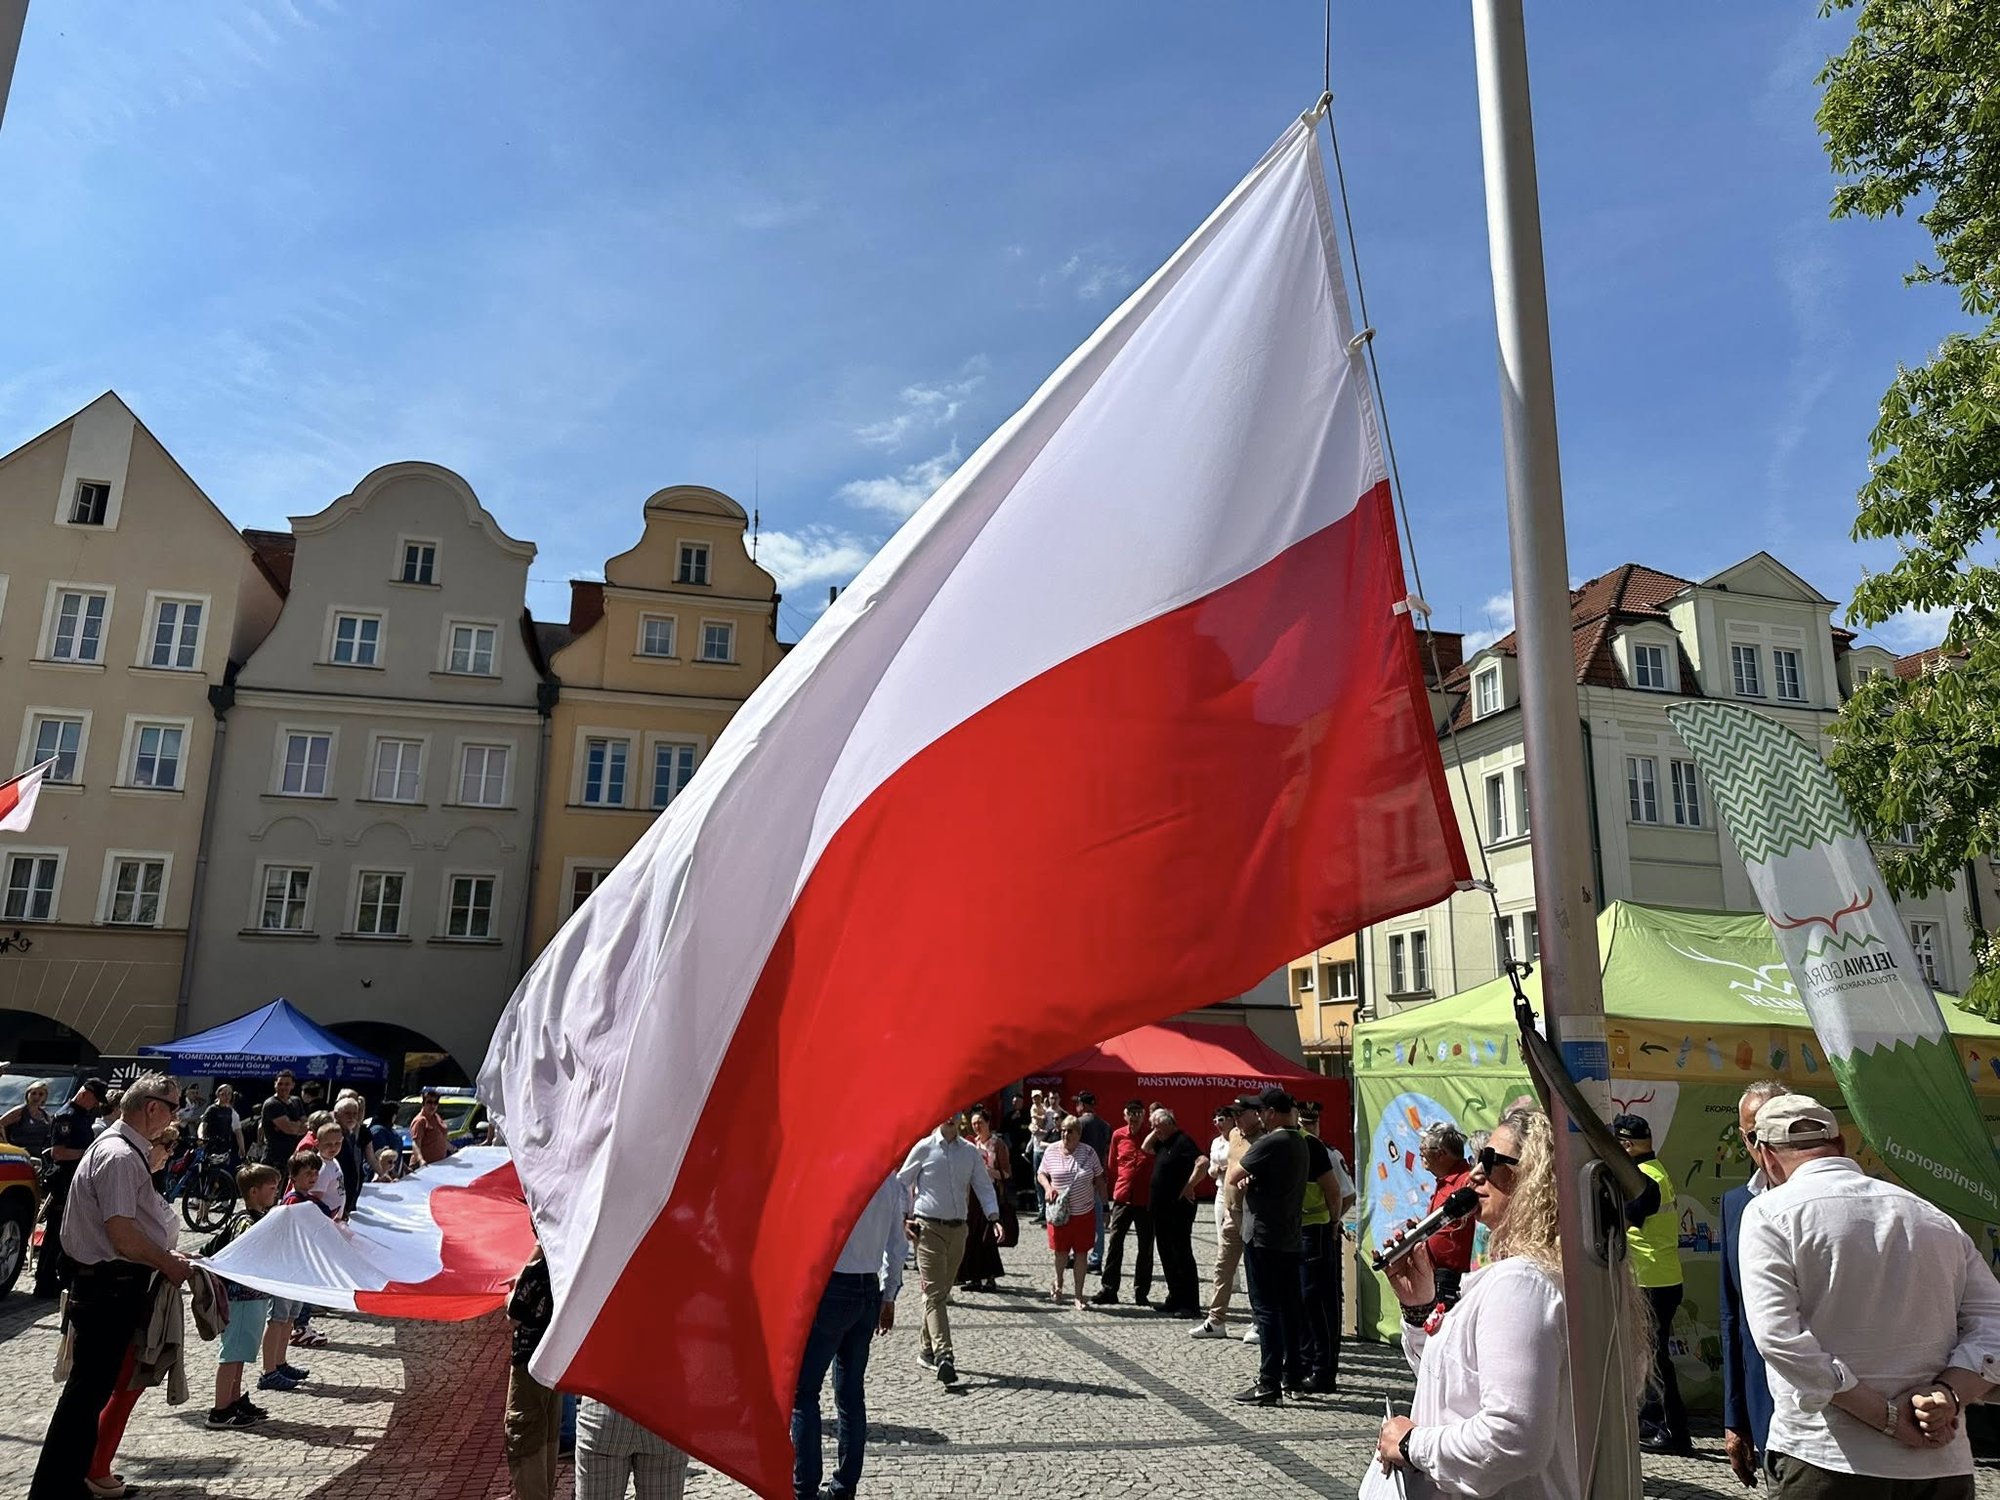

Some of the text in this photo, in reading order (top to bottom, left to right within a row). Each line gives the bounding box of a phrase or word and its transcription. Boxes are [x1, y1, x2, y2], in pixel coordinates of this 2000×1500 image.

[264, 1055, 298, 1063] POLICJI
[212, 1061, 244, 1069] Jeleniej
[1137, 1075, 1284, 1091] PAŃSTWOWA STRAŻ POŻARNA
[1705, 1105, 1739, 1113] EKOPRO
